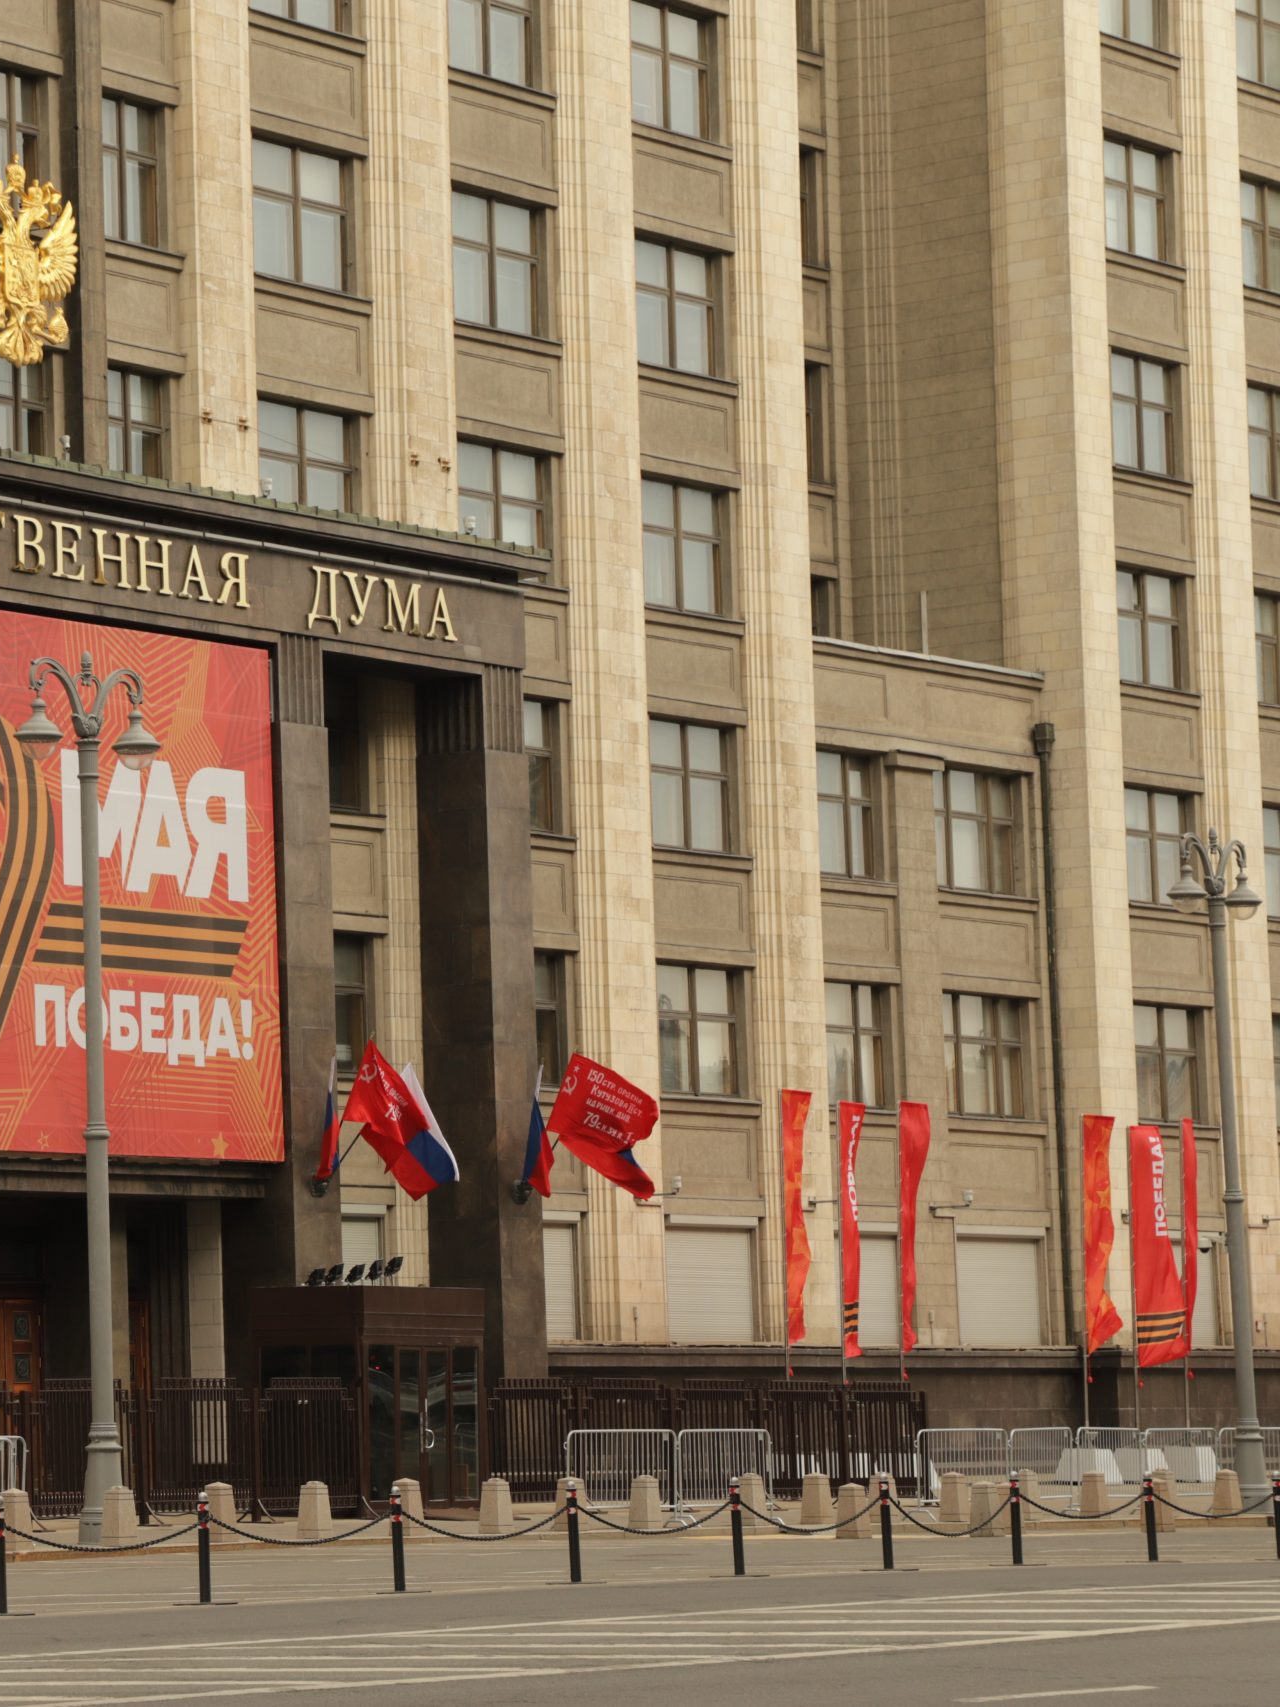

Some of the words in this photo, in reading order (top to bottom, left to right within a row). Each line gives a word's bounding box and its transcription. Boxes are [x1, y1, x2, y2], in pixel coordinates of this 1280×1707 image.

[308, 565, 458, 642] ДУМА
[60, 748, 250, 903] МАЯ
[34, 983, 255, 1068] ПОБЕДА!
